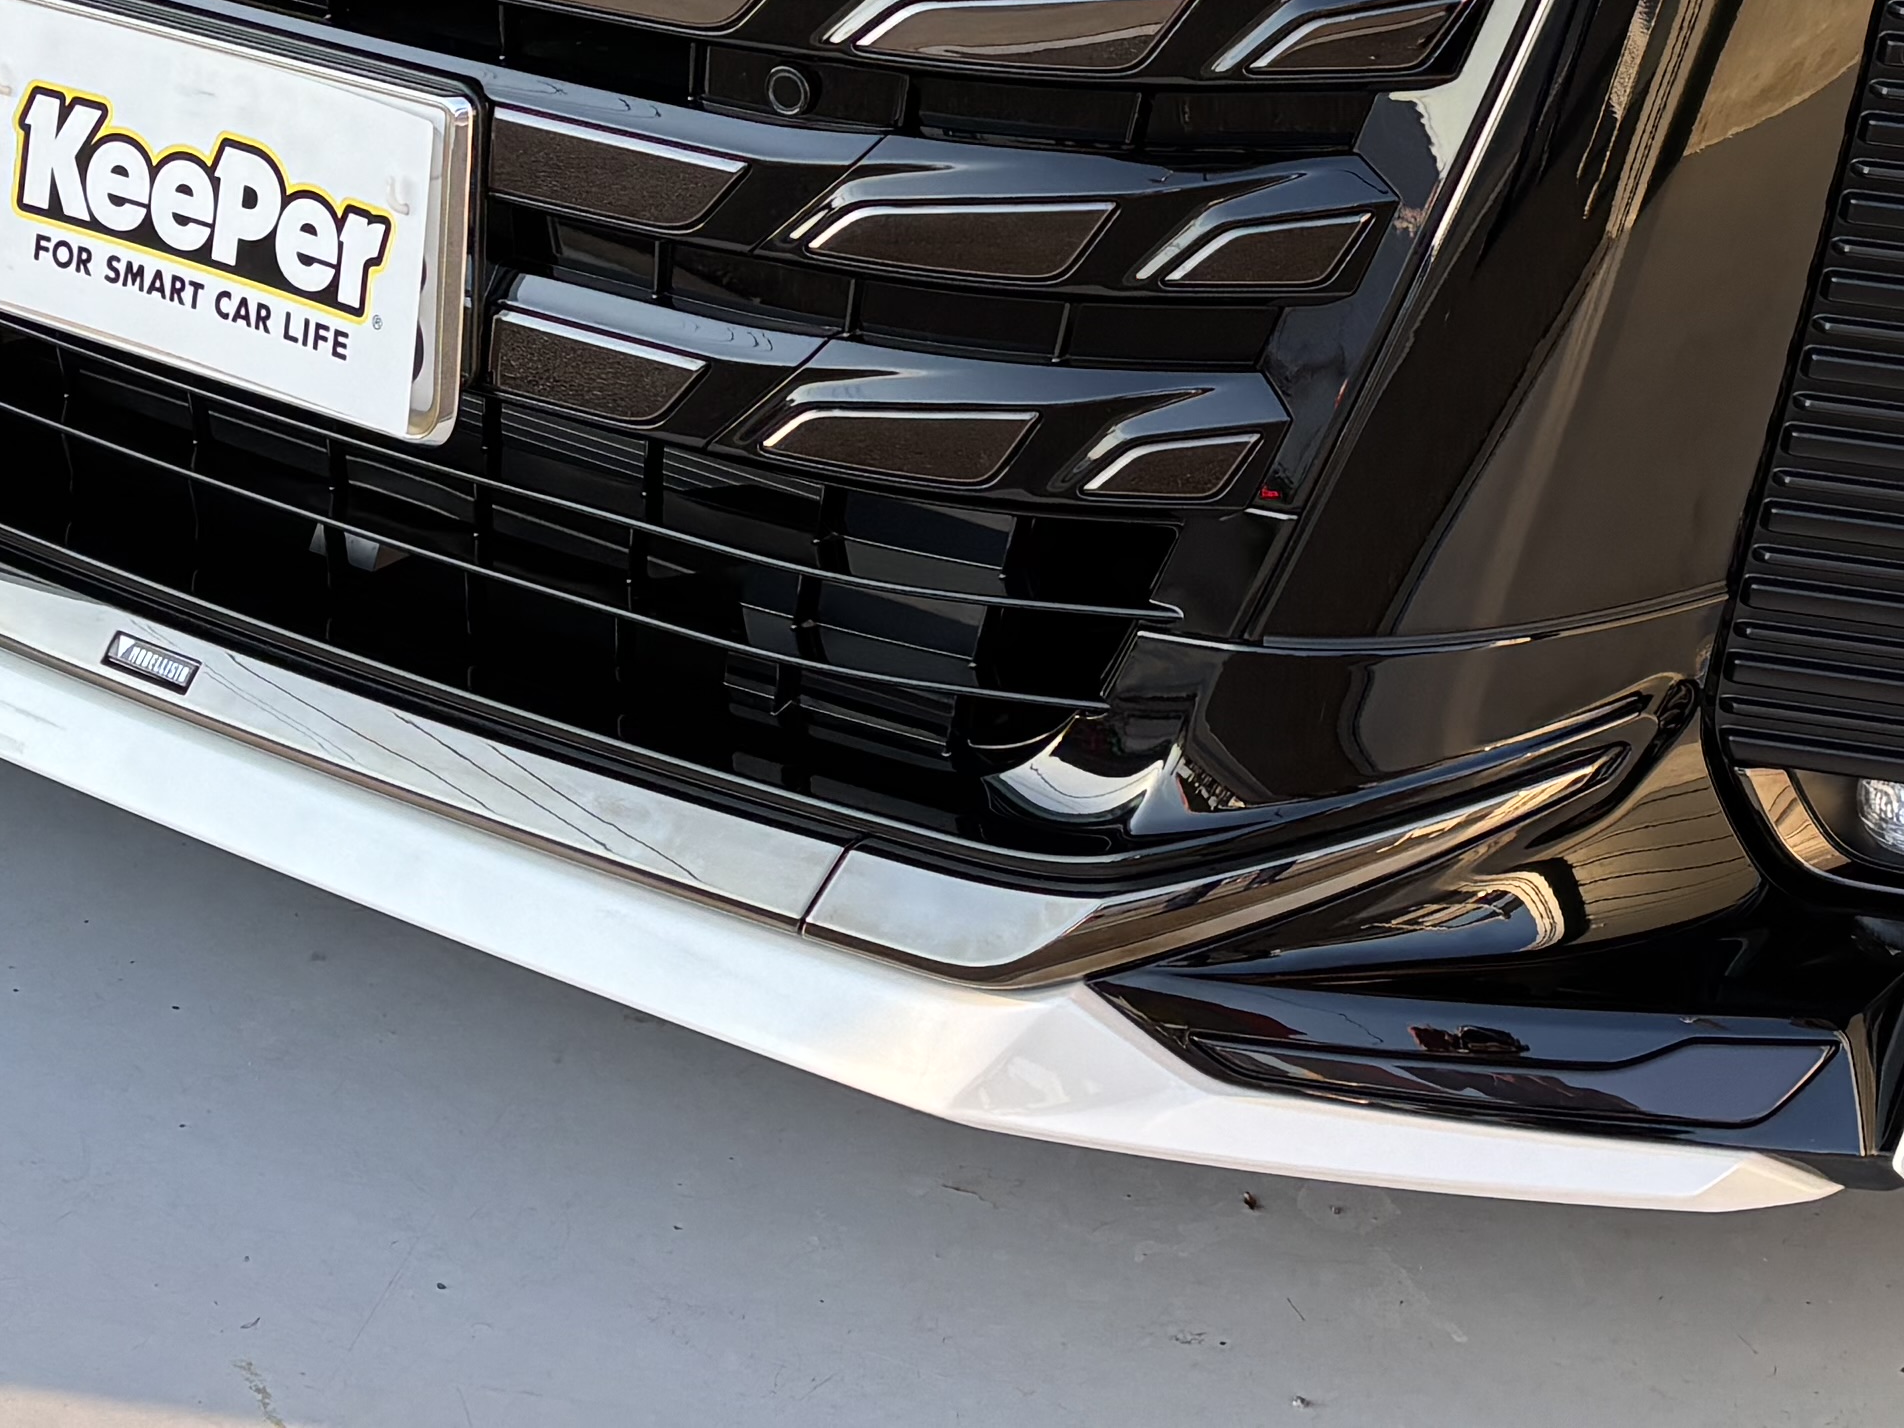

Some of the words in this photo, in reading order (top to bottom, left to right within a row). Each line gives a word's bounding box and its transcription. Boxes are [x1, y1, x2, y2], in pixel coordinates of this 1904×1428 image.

[33, 233, 93, 277] FOR
[103, 254, 205, 311] SMART
[214, 290, 272, 335] CAR
[282, 311, 350, 362] LIFE
